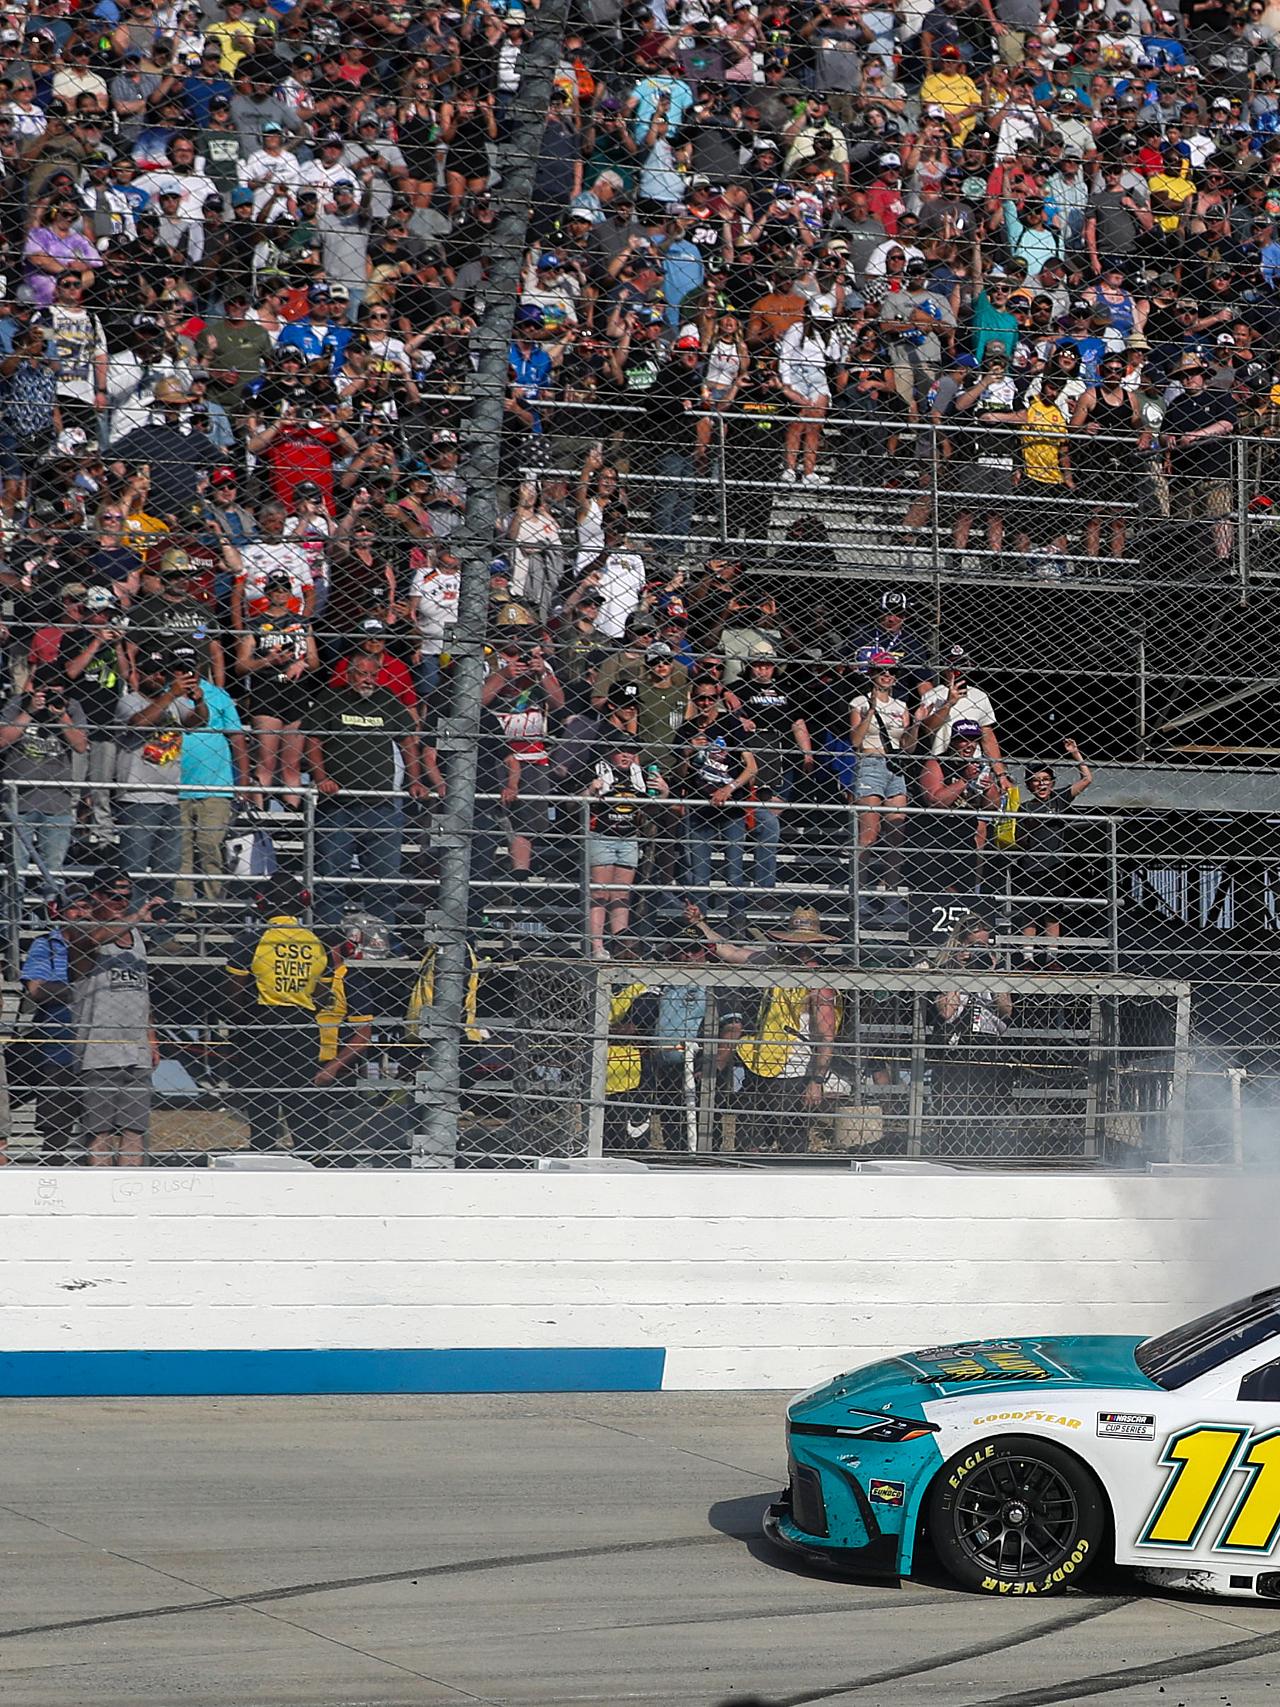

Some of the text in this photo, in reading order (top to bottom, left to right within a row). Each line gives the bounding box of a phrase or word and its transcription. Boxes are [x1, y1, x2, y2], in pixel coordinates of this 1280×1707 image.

[275, 943, 312, 959] CSC
[275, 960, 312, 976] EVENT
[973, 1409, 1084, 1430] GOODYEAR
[1116, 1414, 1147, 1424] NASCAR
[1105, 1424, 1147, 1434] CUP SERIES
[949, 1444, 995, 1490] EAGLE
[873, 1487, 902, 1500] SUNOCO
[981, 1539, 1090, 1595] GOODYEAR
